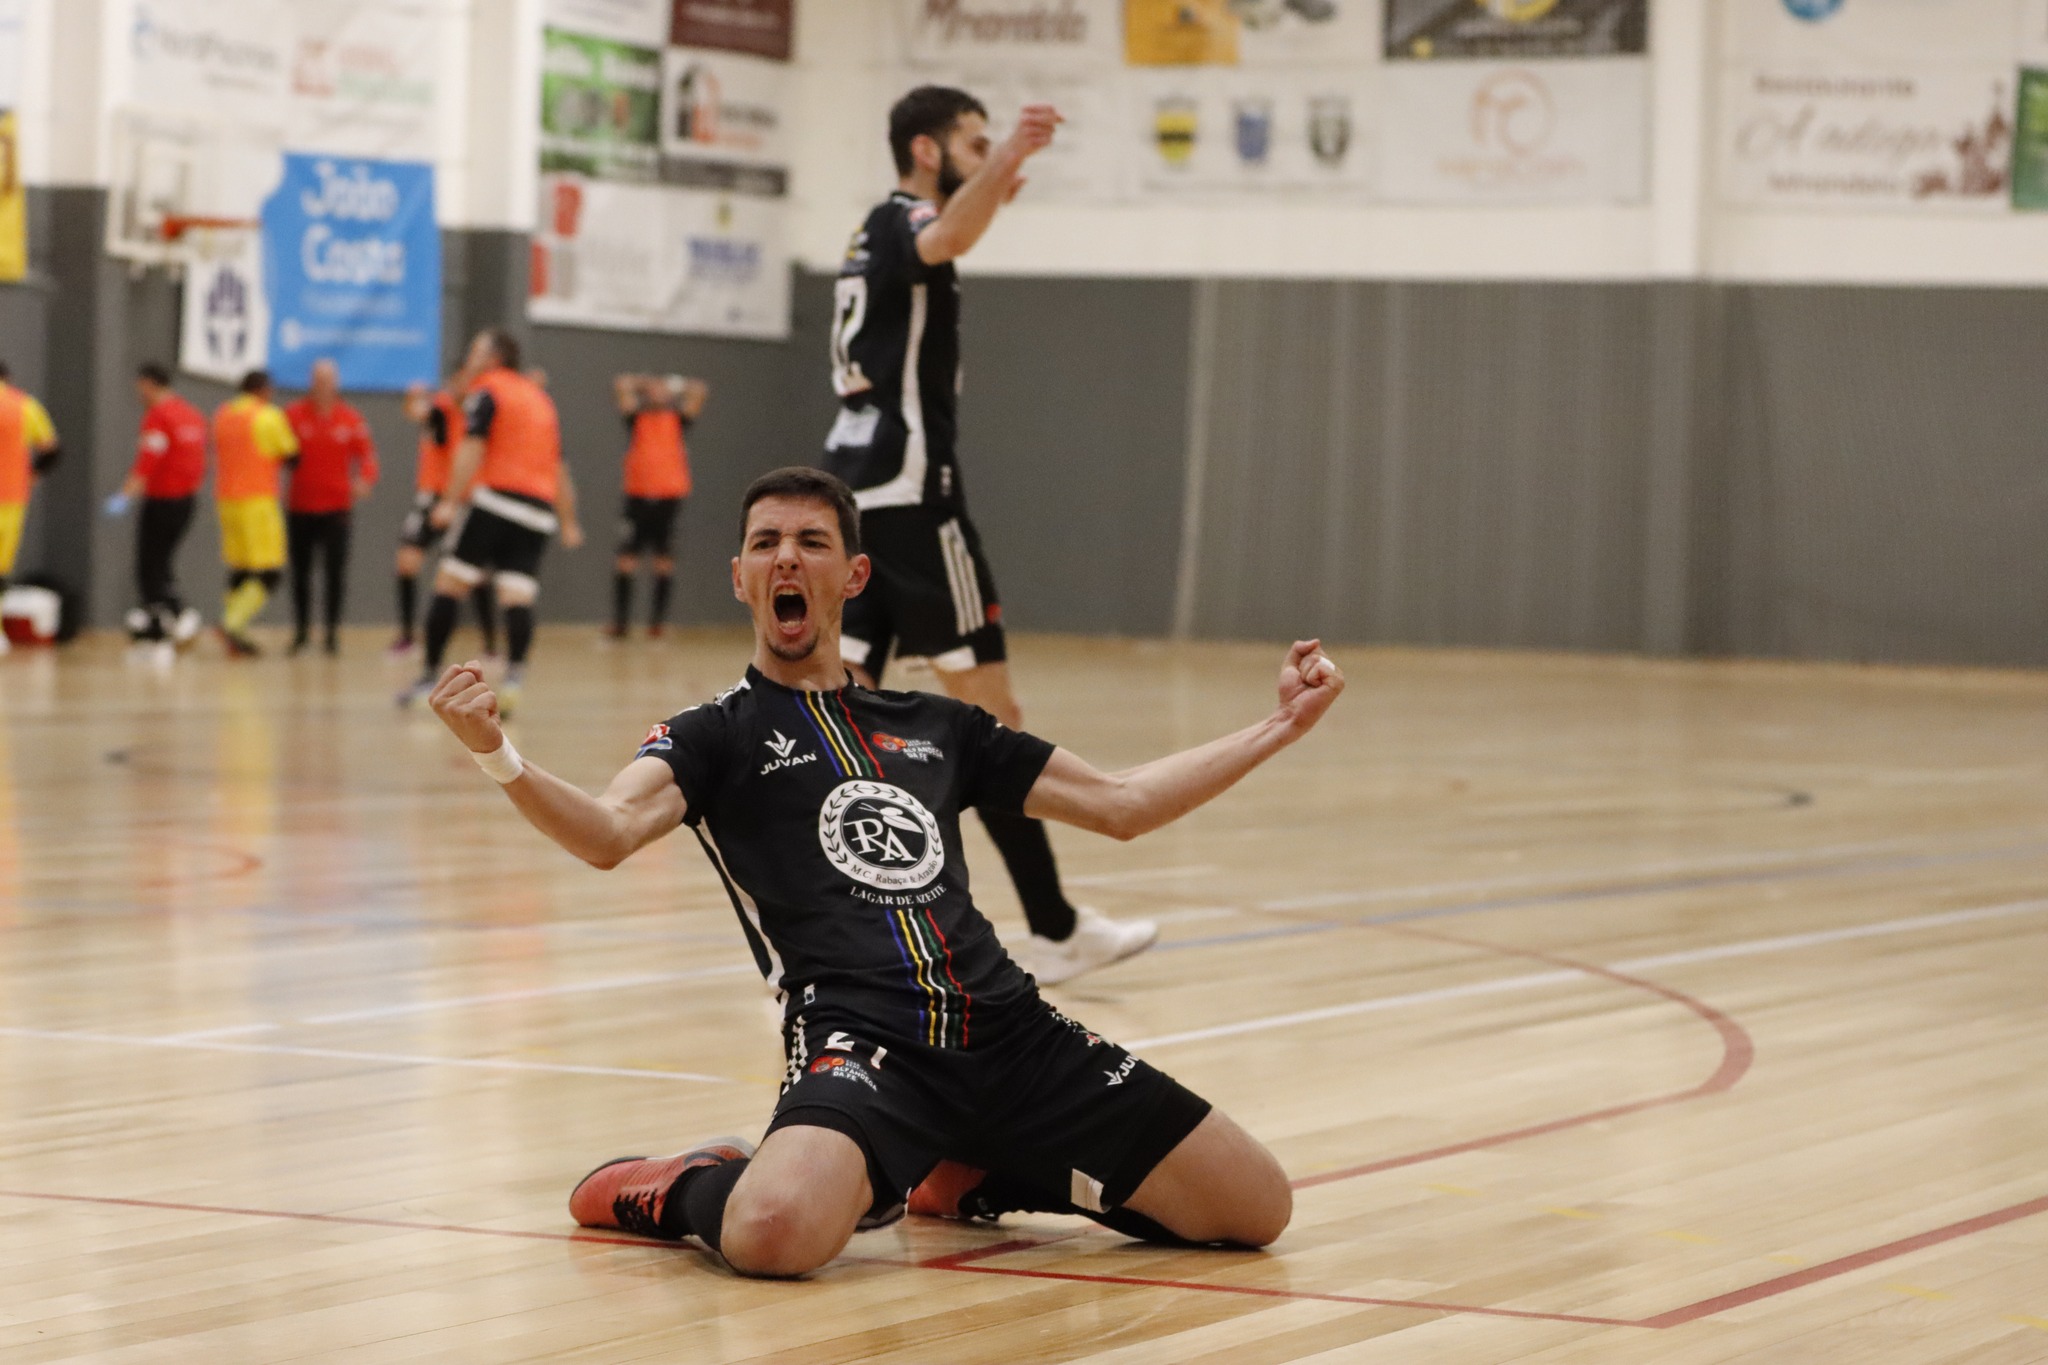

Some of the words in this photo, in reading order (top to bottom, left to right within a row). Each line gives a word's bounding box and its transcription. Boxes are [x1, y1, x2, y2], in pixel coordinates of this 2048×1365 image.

[760, 752, 817, 775] JUVAN
[843, 818, 918, 861] RA
[850, 886, 894, 905] LAGAR
[896, 895, 914, 906] DE
[916, 883, 947, 904] AZEITE
